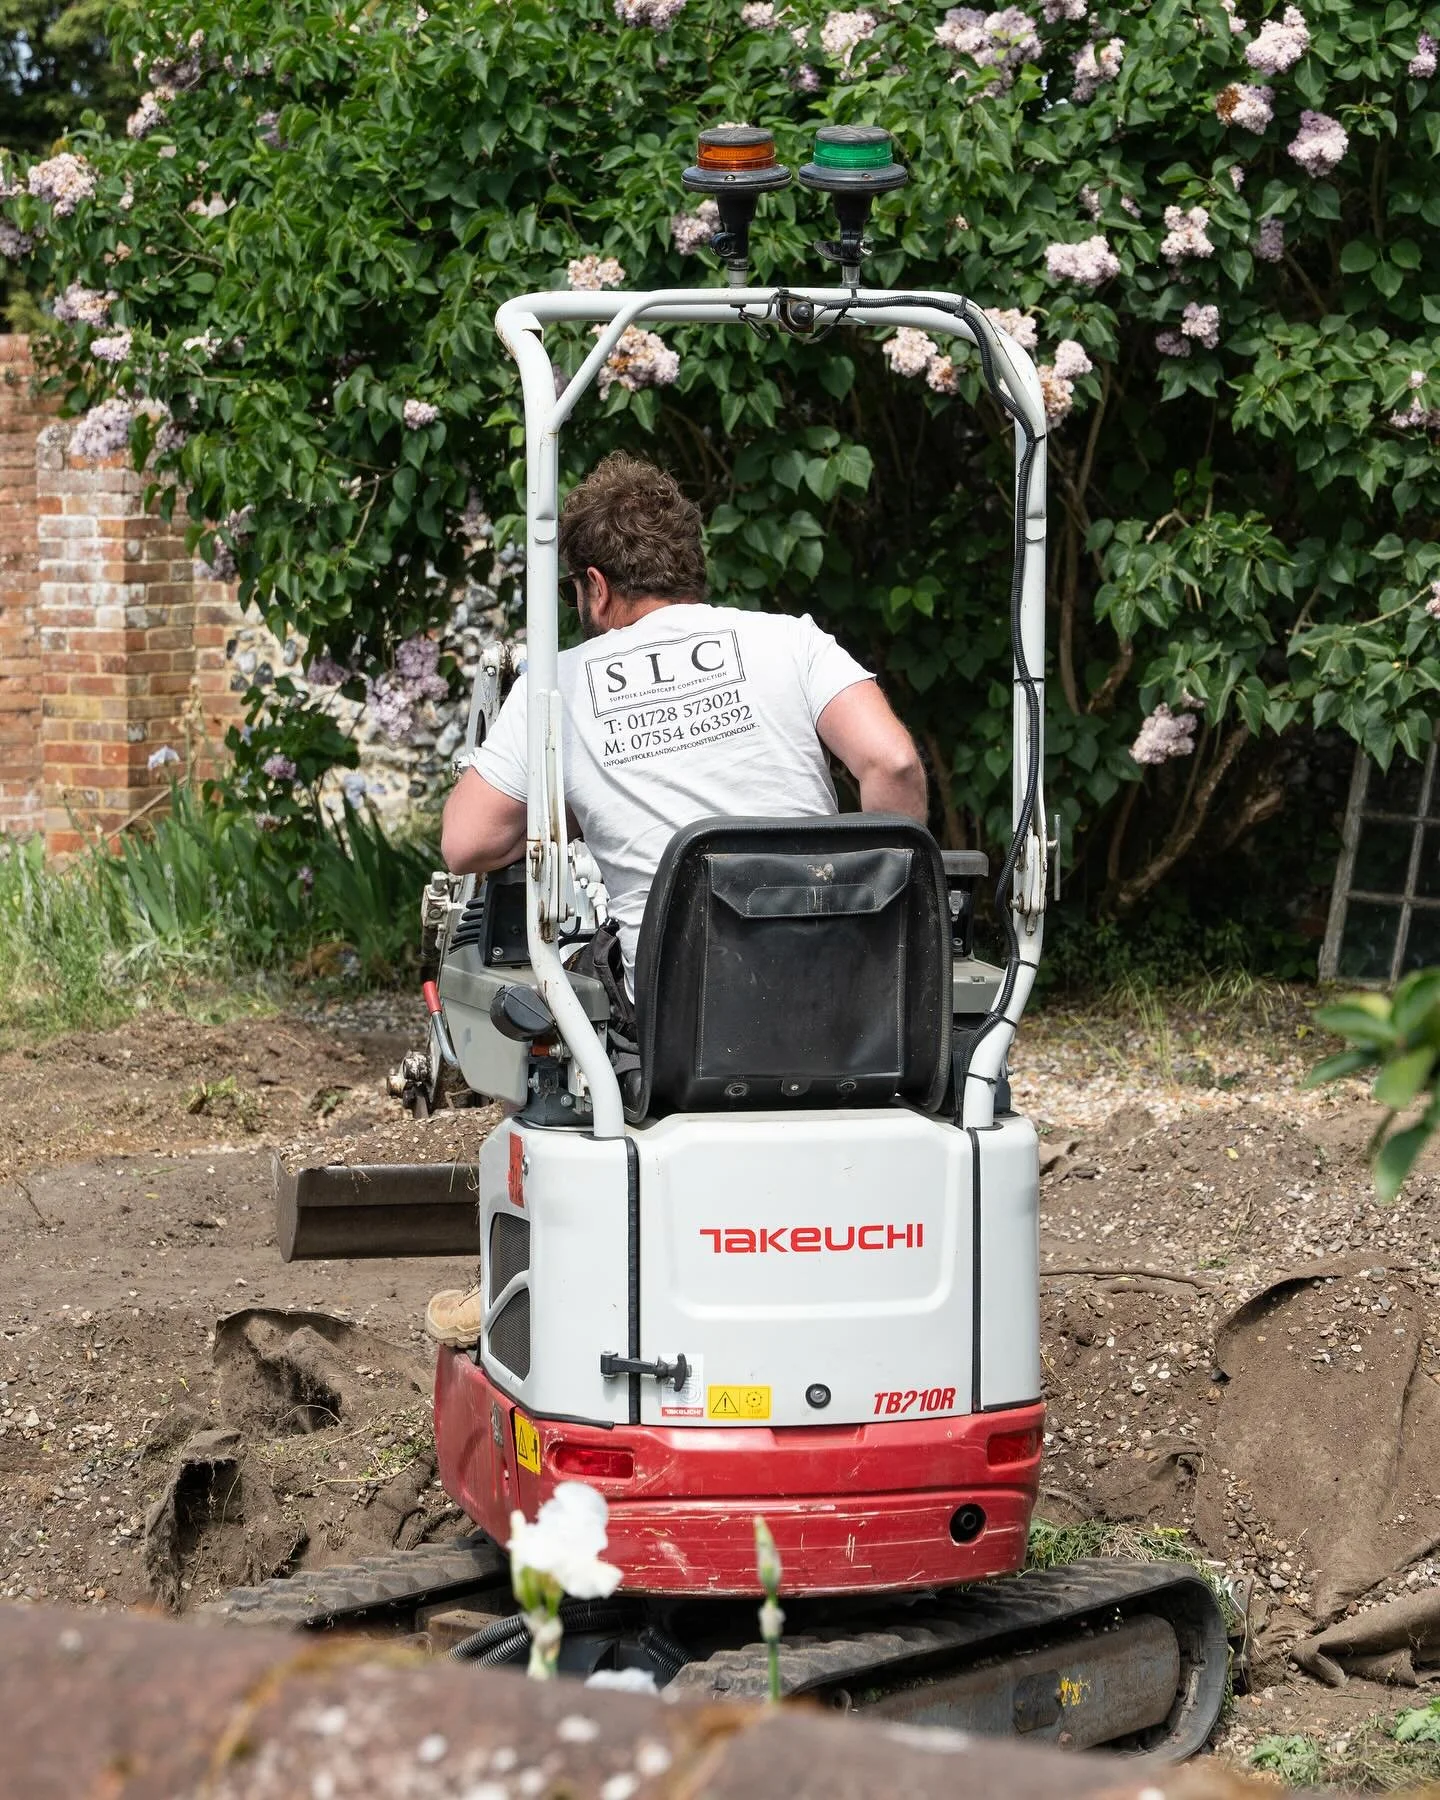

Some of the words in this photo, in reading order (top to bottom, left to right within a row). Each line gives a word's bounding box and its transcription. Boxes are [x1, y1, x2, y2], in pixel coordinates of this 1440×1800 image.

[609, 692, 638, 702] SUFFOLK
[639, 686, 675, 696] LANDSCAPE
[678, 672, 727, 690] CONSTRUCTION
[604, 719, 622, 734] T:
[627, 707, 678, 729] 01728
[684, 689, 741, 717] 573021
[604, 740, 625, 756] M:
[631, 726, 684, 750] 07554
[690, 706, 752, 736] 663592
[874, 1388, 956, 1414] TB210R
